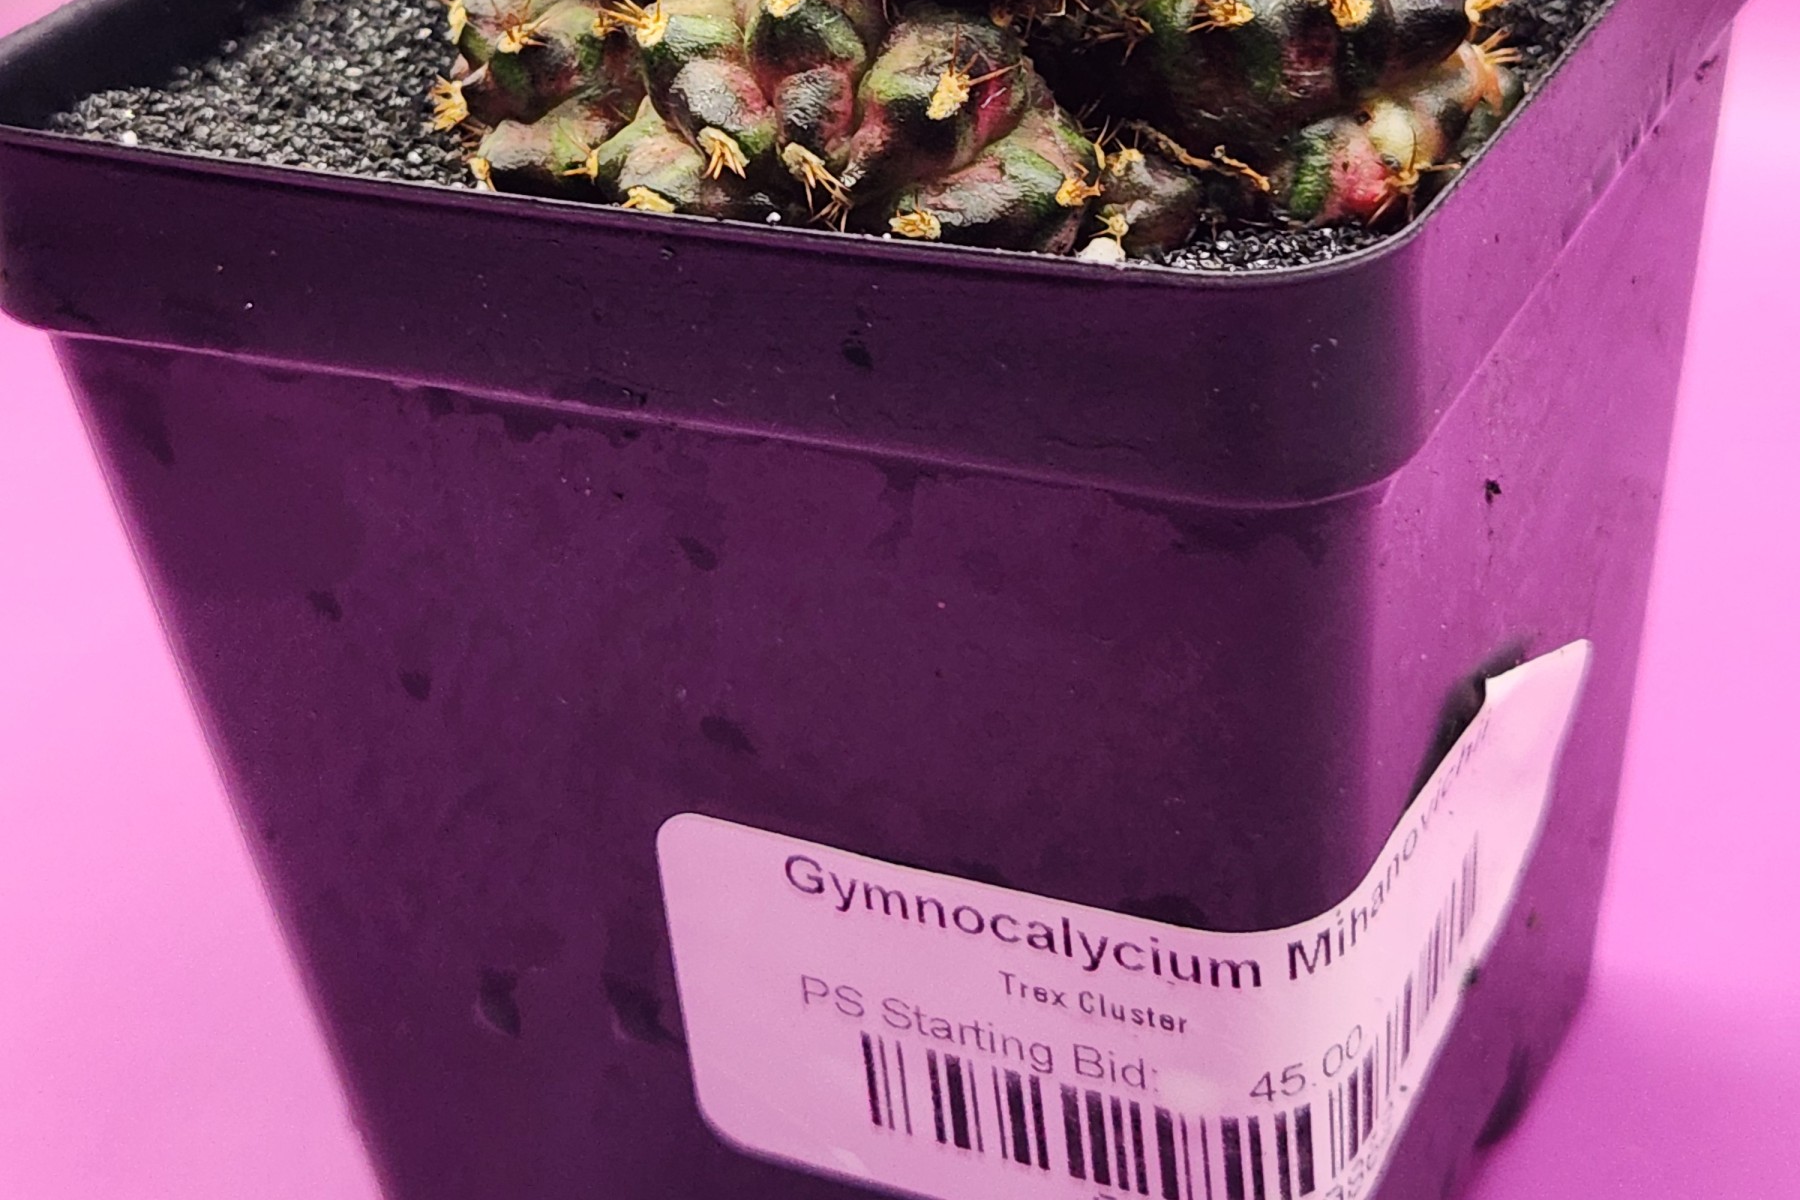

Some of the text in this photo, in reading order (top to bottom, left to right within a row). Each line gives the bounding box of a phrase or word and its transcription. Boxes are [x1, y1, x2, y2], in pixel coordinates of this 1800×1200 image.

[784, 854, 1263, 990] Gymnocalycium
[801, 974, 866, 1019] PS
[882, 997, 1054, 1075] Starting
[1249, 1024, 1363, 1103] 45.00
[999, 970, 1188, 1035] Trex Cluster
